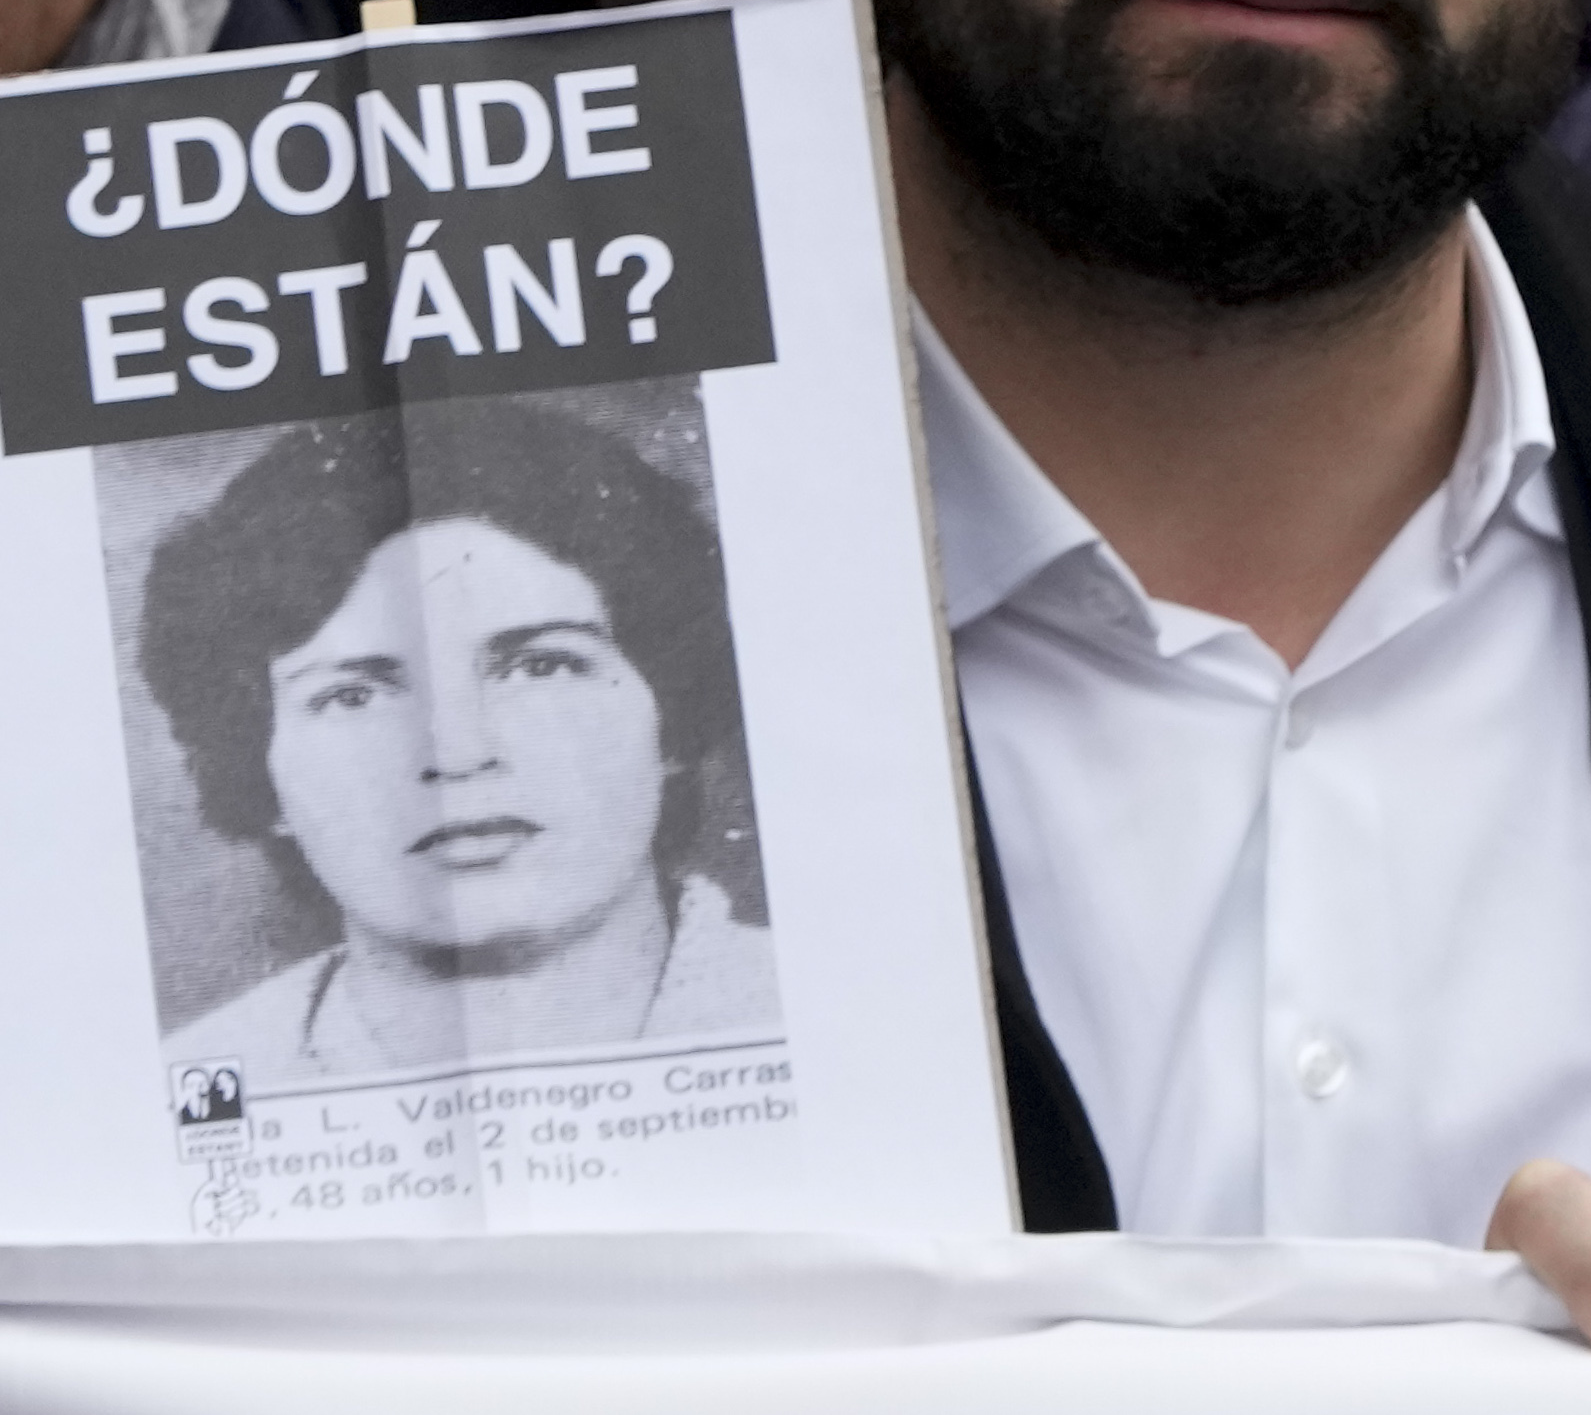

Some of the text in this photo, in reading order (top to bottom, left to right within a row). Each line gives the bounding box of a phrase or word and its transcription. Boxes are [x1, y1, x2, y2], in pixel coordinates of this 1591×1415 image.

[64, 63, 654, 239] ¿DÓNDE
[81, 218, 676, 406] ESTÁN?
[319, 1103, 362, 1135] L.
[395, 1076, 634, 1125] Valdenegro
[662, 1058, 794, 1095] Carras
[423, 1128, 456, 1161] el
[479, 1119, 506, 1150] 2
[529, 1117, 580, 1145] de
[290, 1180, 346, 1211] 48
[360, 1168, 474, 1207] años,
[486, 1158, 505, 1186] 1
[526, 1153, 620, 1185] hijo.
